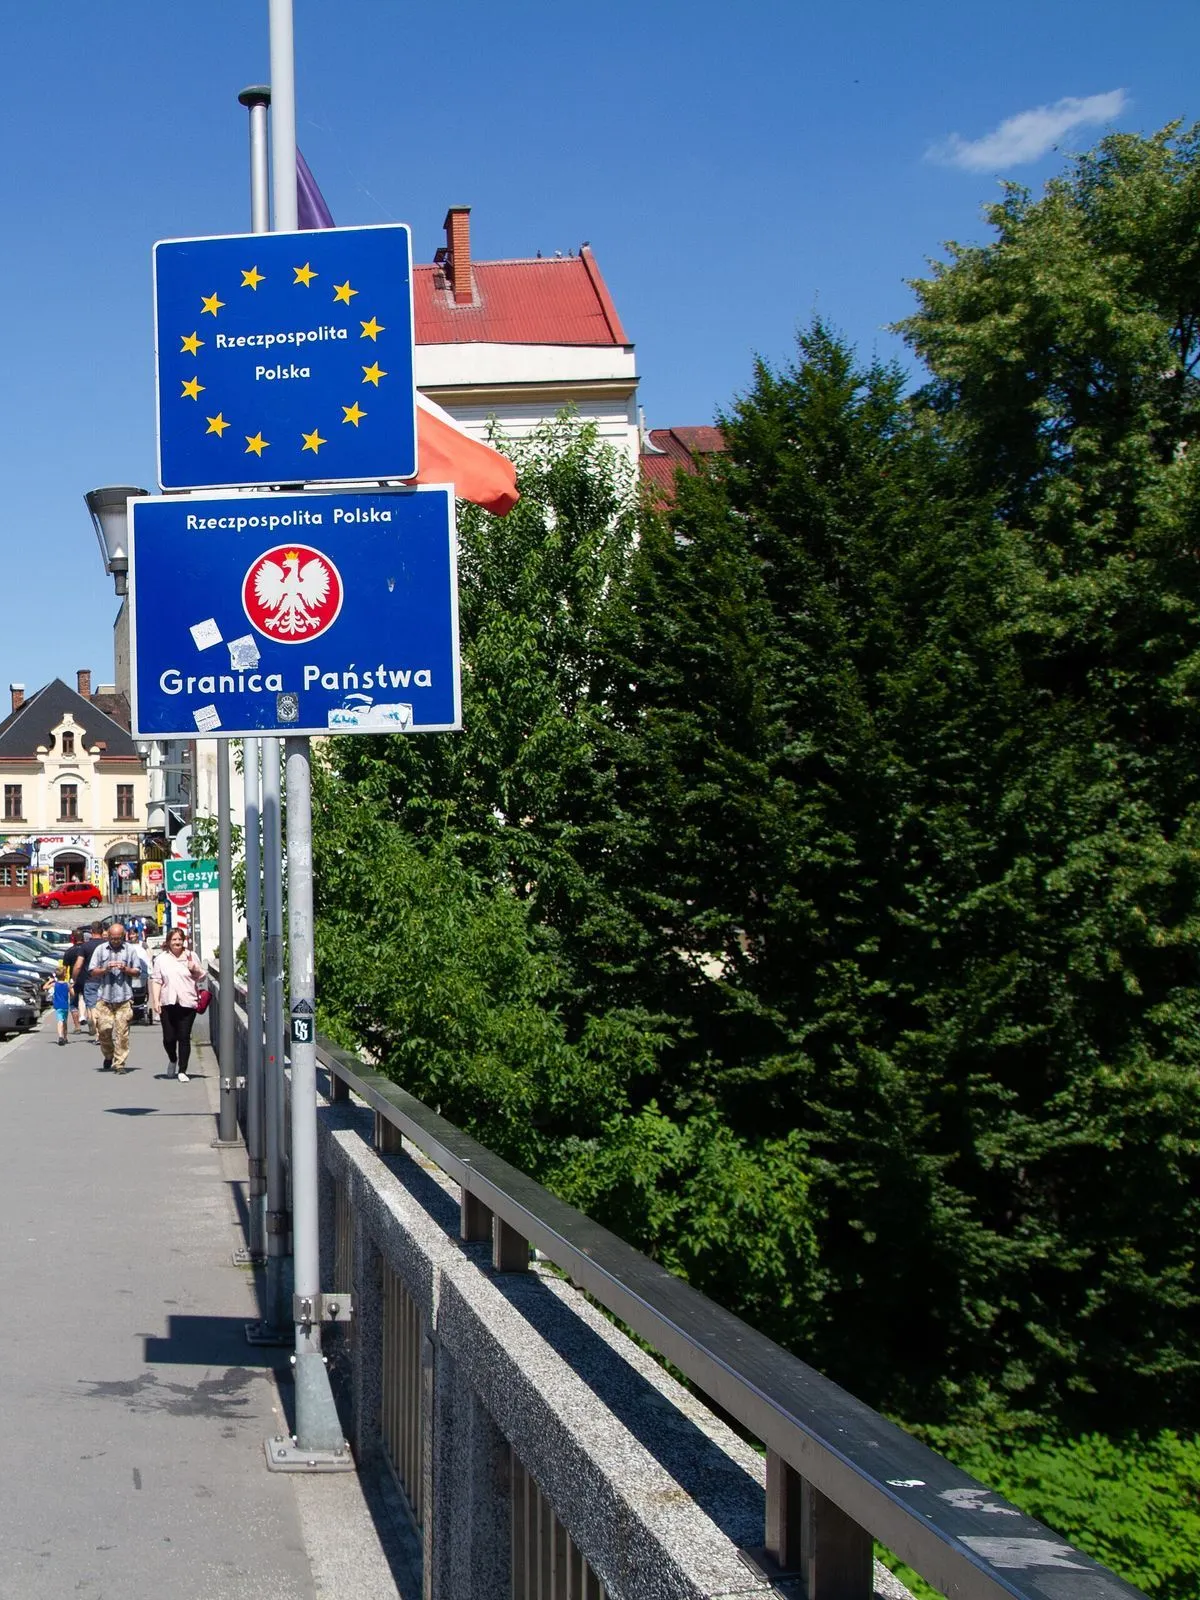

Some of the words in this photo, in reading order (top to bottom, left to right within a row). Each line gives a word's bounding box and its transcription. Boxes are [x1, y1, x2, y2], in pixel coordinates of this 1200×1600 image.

[216, 326, 348, 349] Rzeczpospolita
[255, 364, 310, 381] Polska
[186, 510, 323, 532] Rzeczpospolita
[333, 507, 392, 524] Polska
[159, 668, 283, 695] Granica
[303, 663, 432, 691] Państwa
